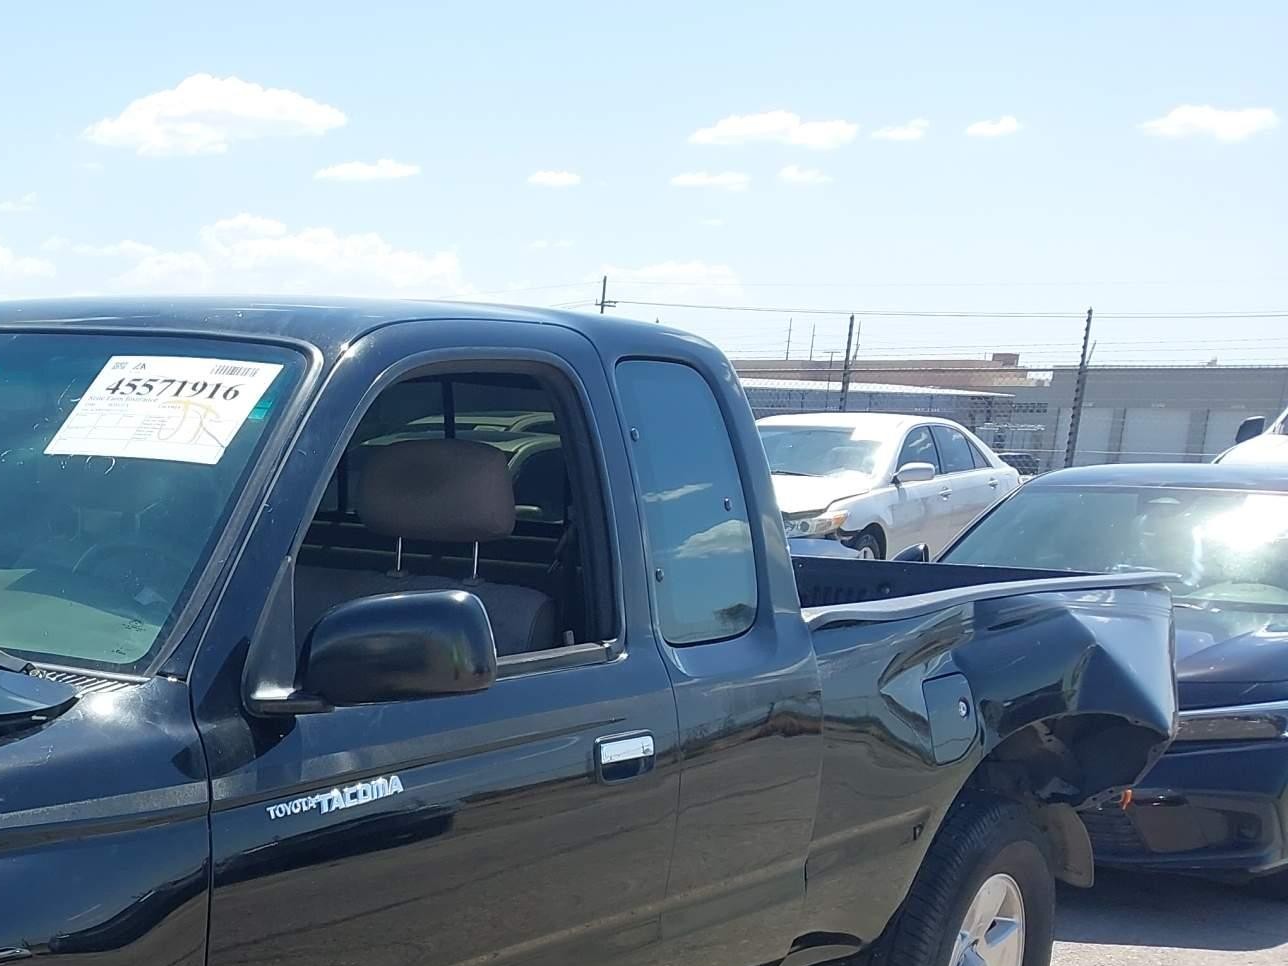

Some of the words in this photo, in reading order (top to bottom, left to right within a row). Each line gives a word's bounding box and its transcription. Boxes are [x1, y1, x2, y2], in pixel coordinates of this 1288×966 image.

[106, 376, 245, 400] 45571916
[266, 795, 316, 820] TOYOTA
[316, 775, 404, 815] TACOMA
